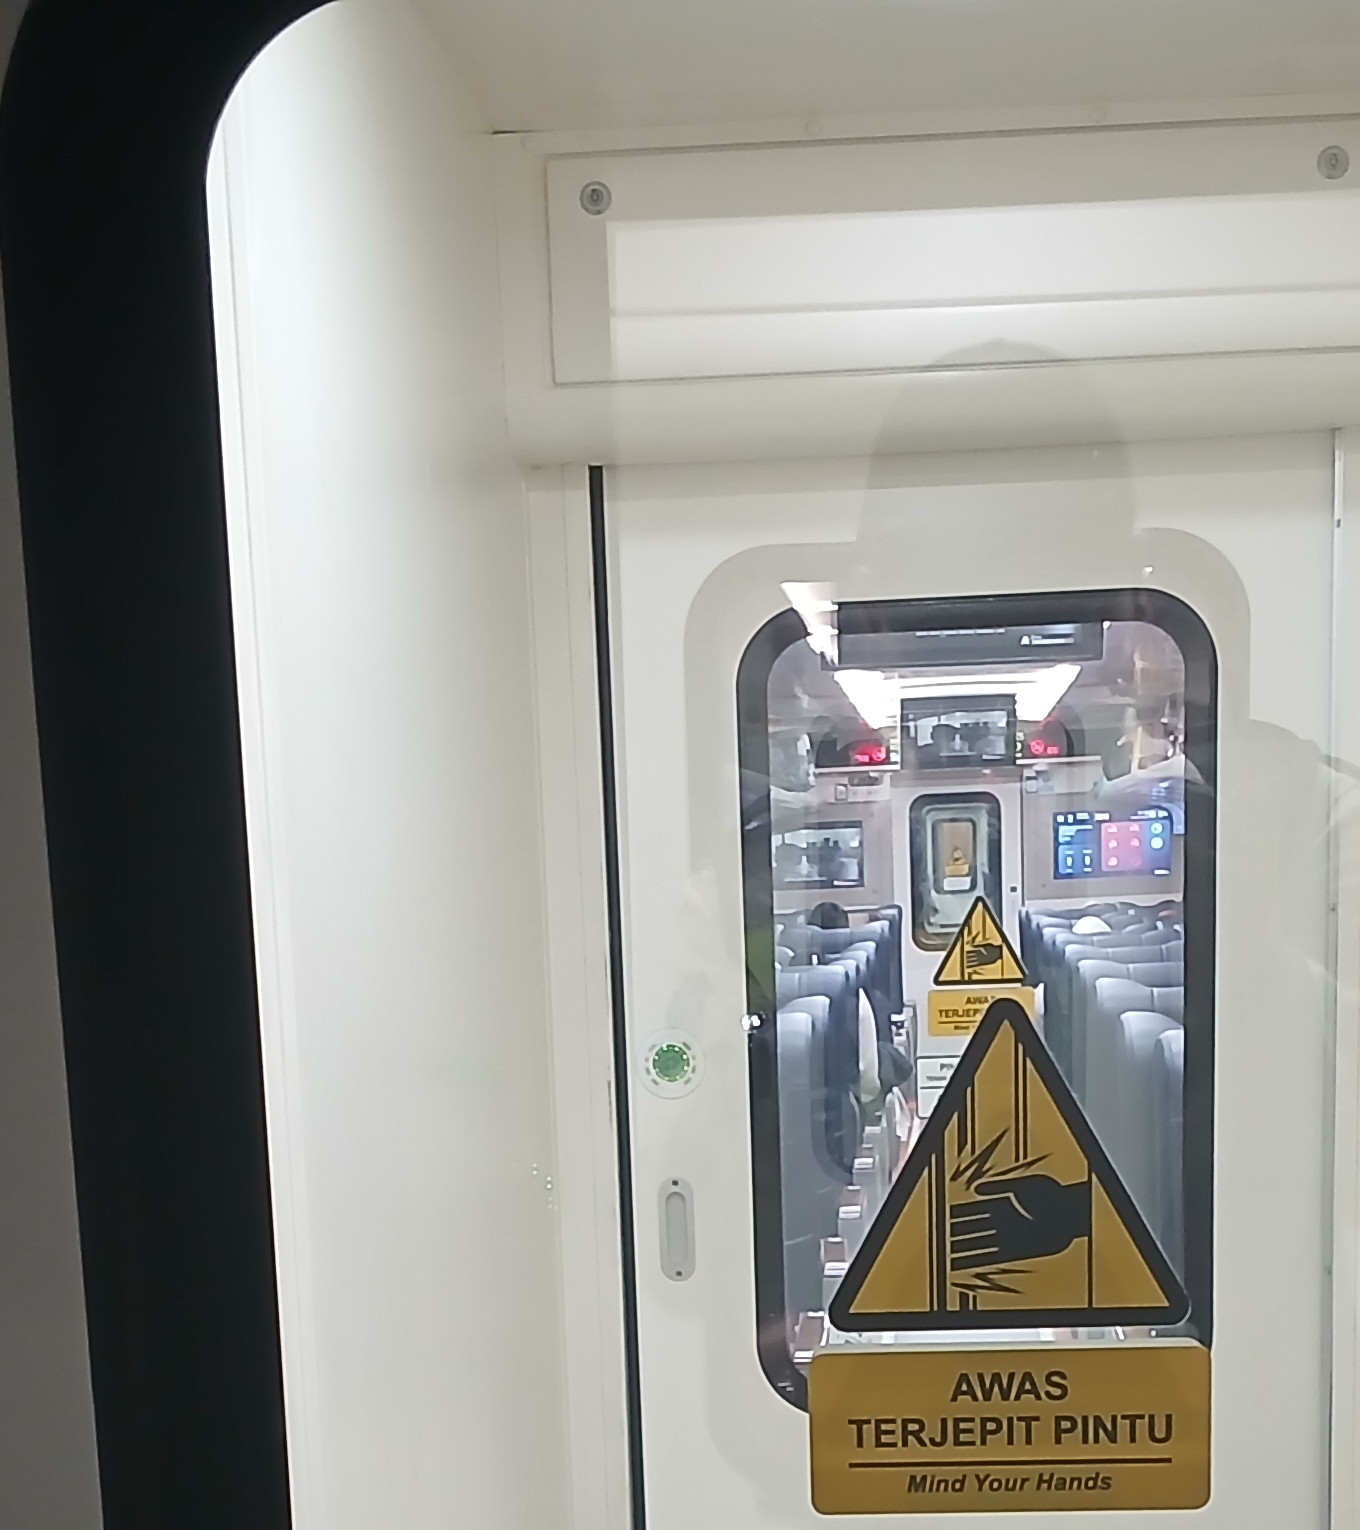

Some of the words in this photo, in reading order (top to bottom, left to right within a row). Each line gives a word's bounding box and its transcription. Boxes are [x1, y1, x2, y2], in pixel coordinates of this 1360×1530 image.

[949, 1370, 1069, 1403] AWAS
[847, 1415, 1041, 1449] TERJEPIT
[1054, 1413, 1173, 1446] PINTU
[906, 1473, 967, 1494] Mind
[974, 1472, 1030, 1493] Your
[1035, 1471, 1113, 1492] Hands
